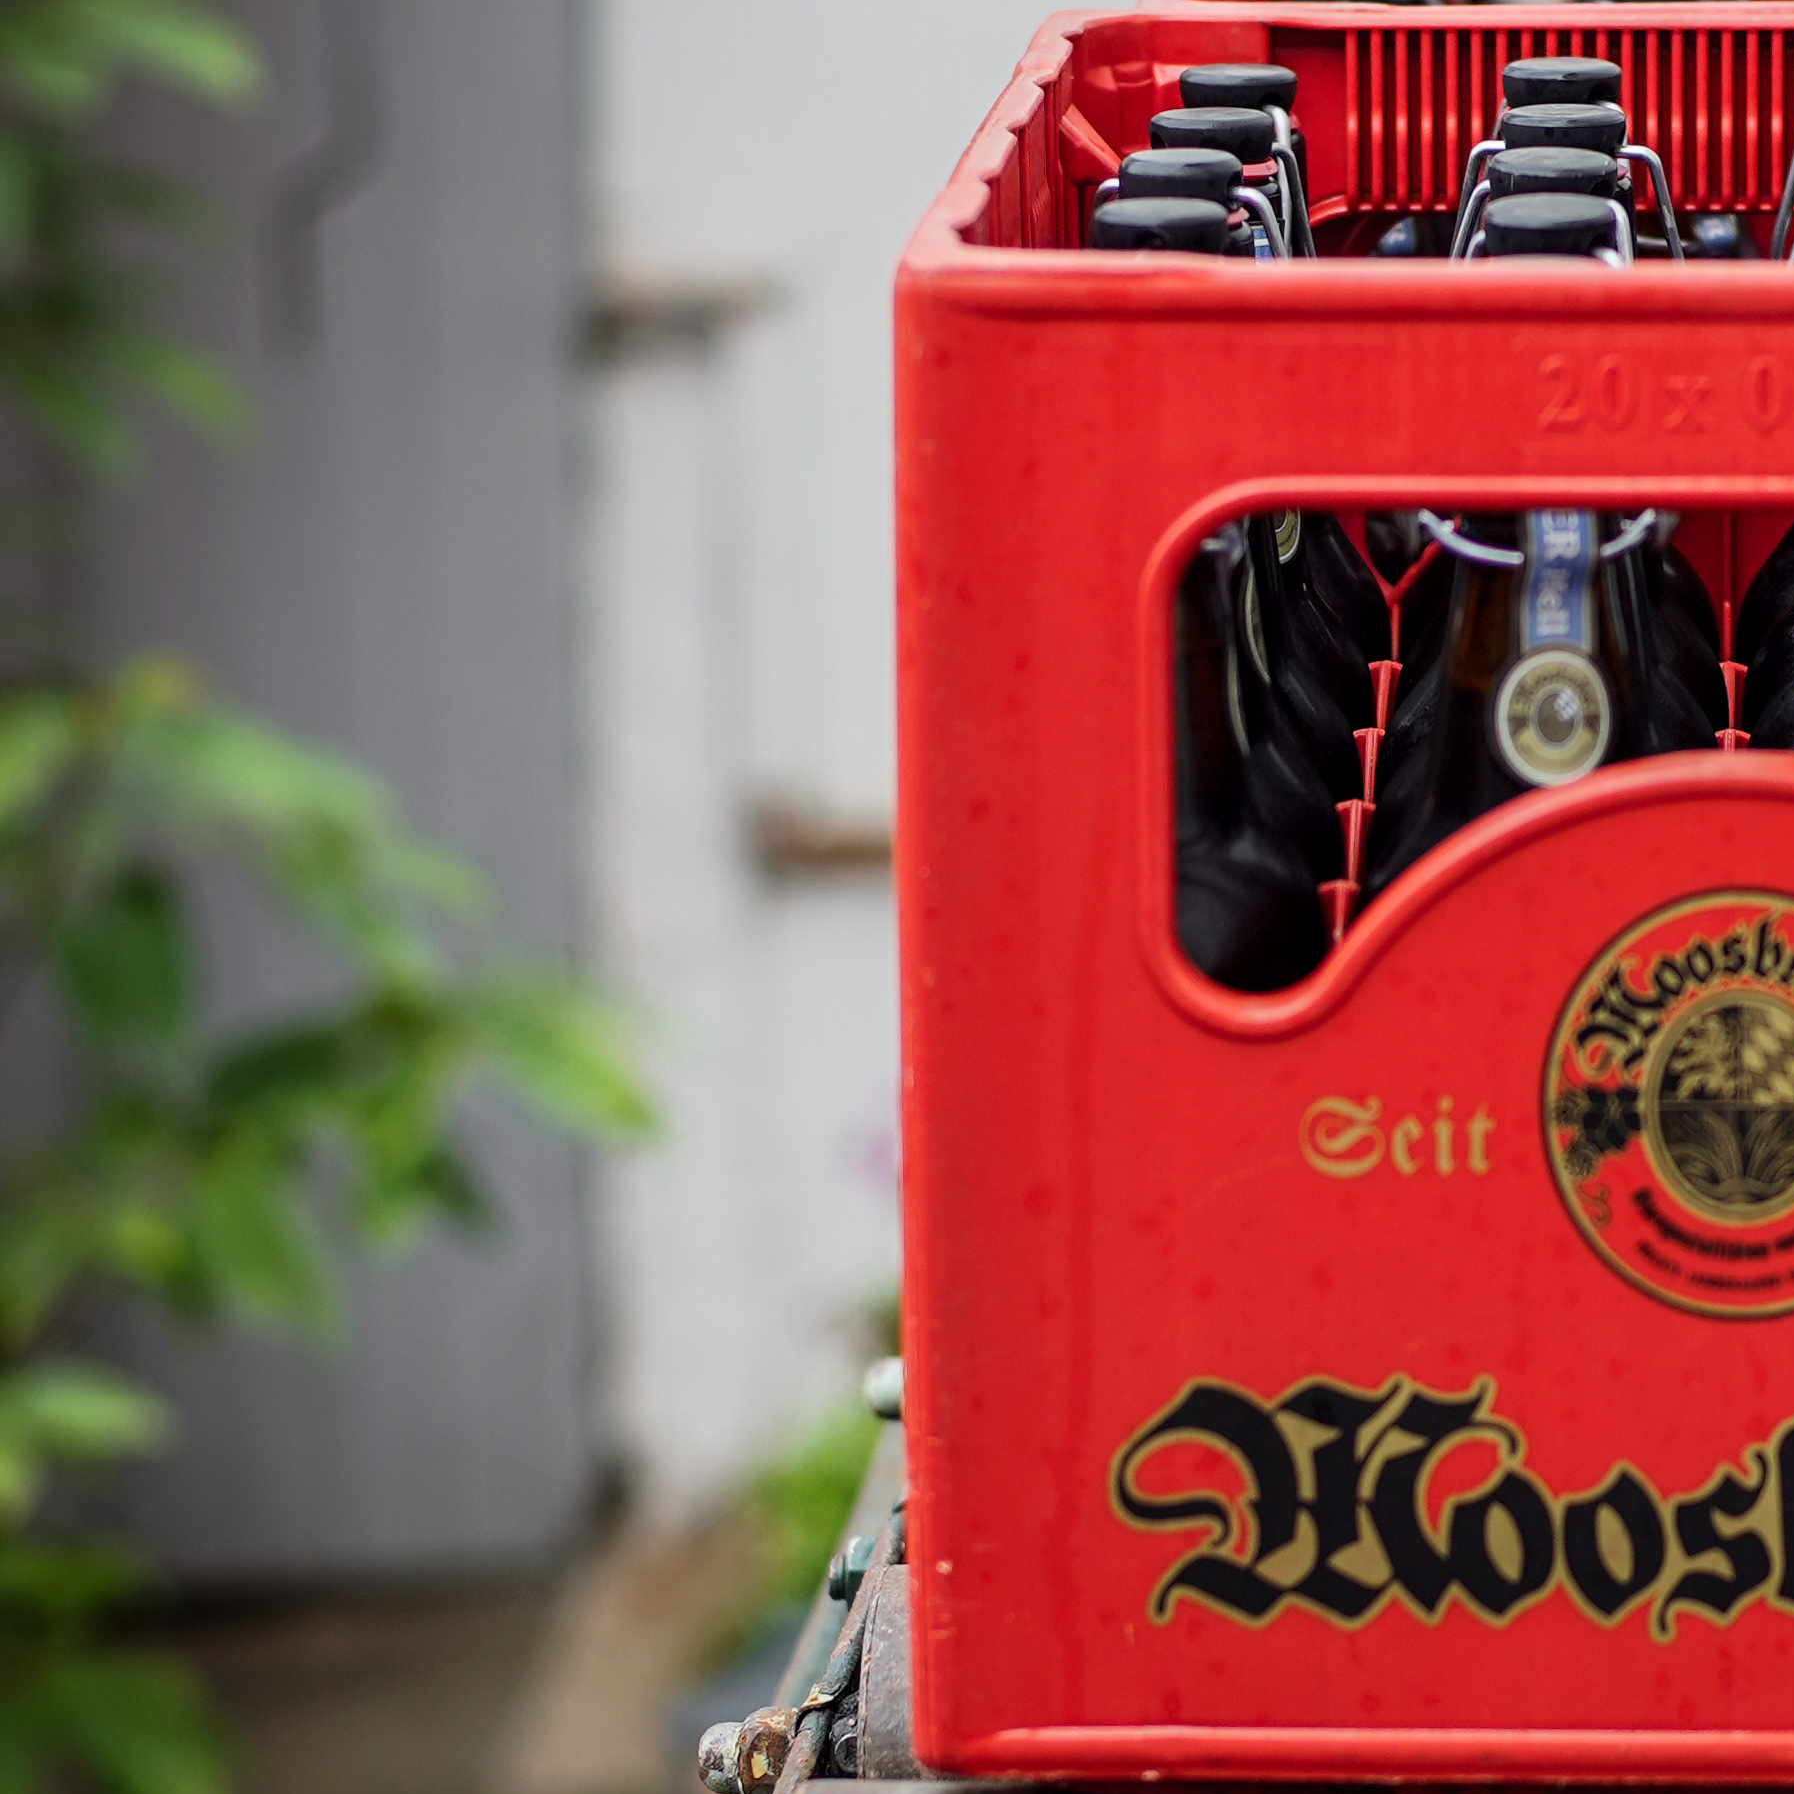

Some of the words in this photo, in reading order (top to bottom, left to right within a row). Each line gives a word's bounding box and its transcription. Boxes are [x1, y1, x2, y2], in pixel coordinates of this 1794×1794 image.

[1537, 352, 1638, 433] 20
[1662, 373, 1716, 433] x
[1298, 1093, 1497, 1181] Seit
